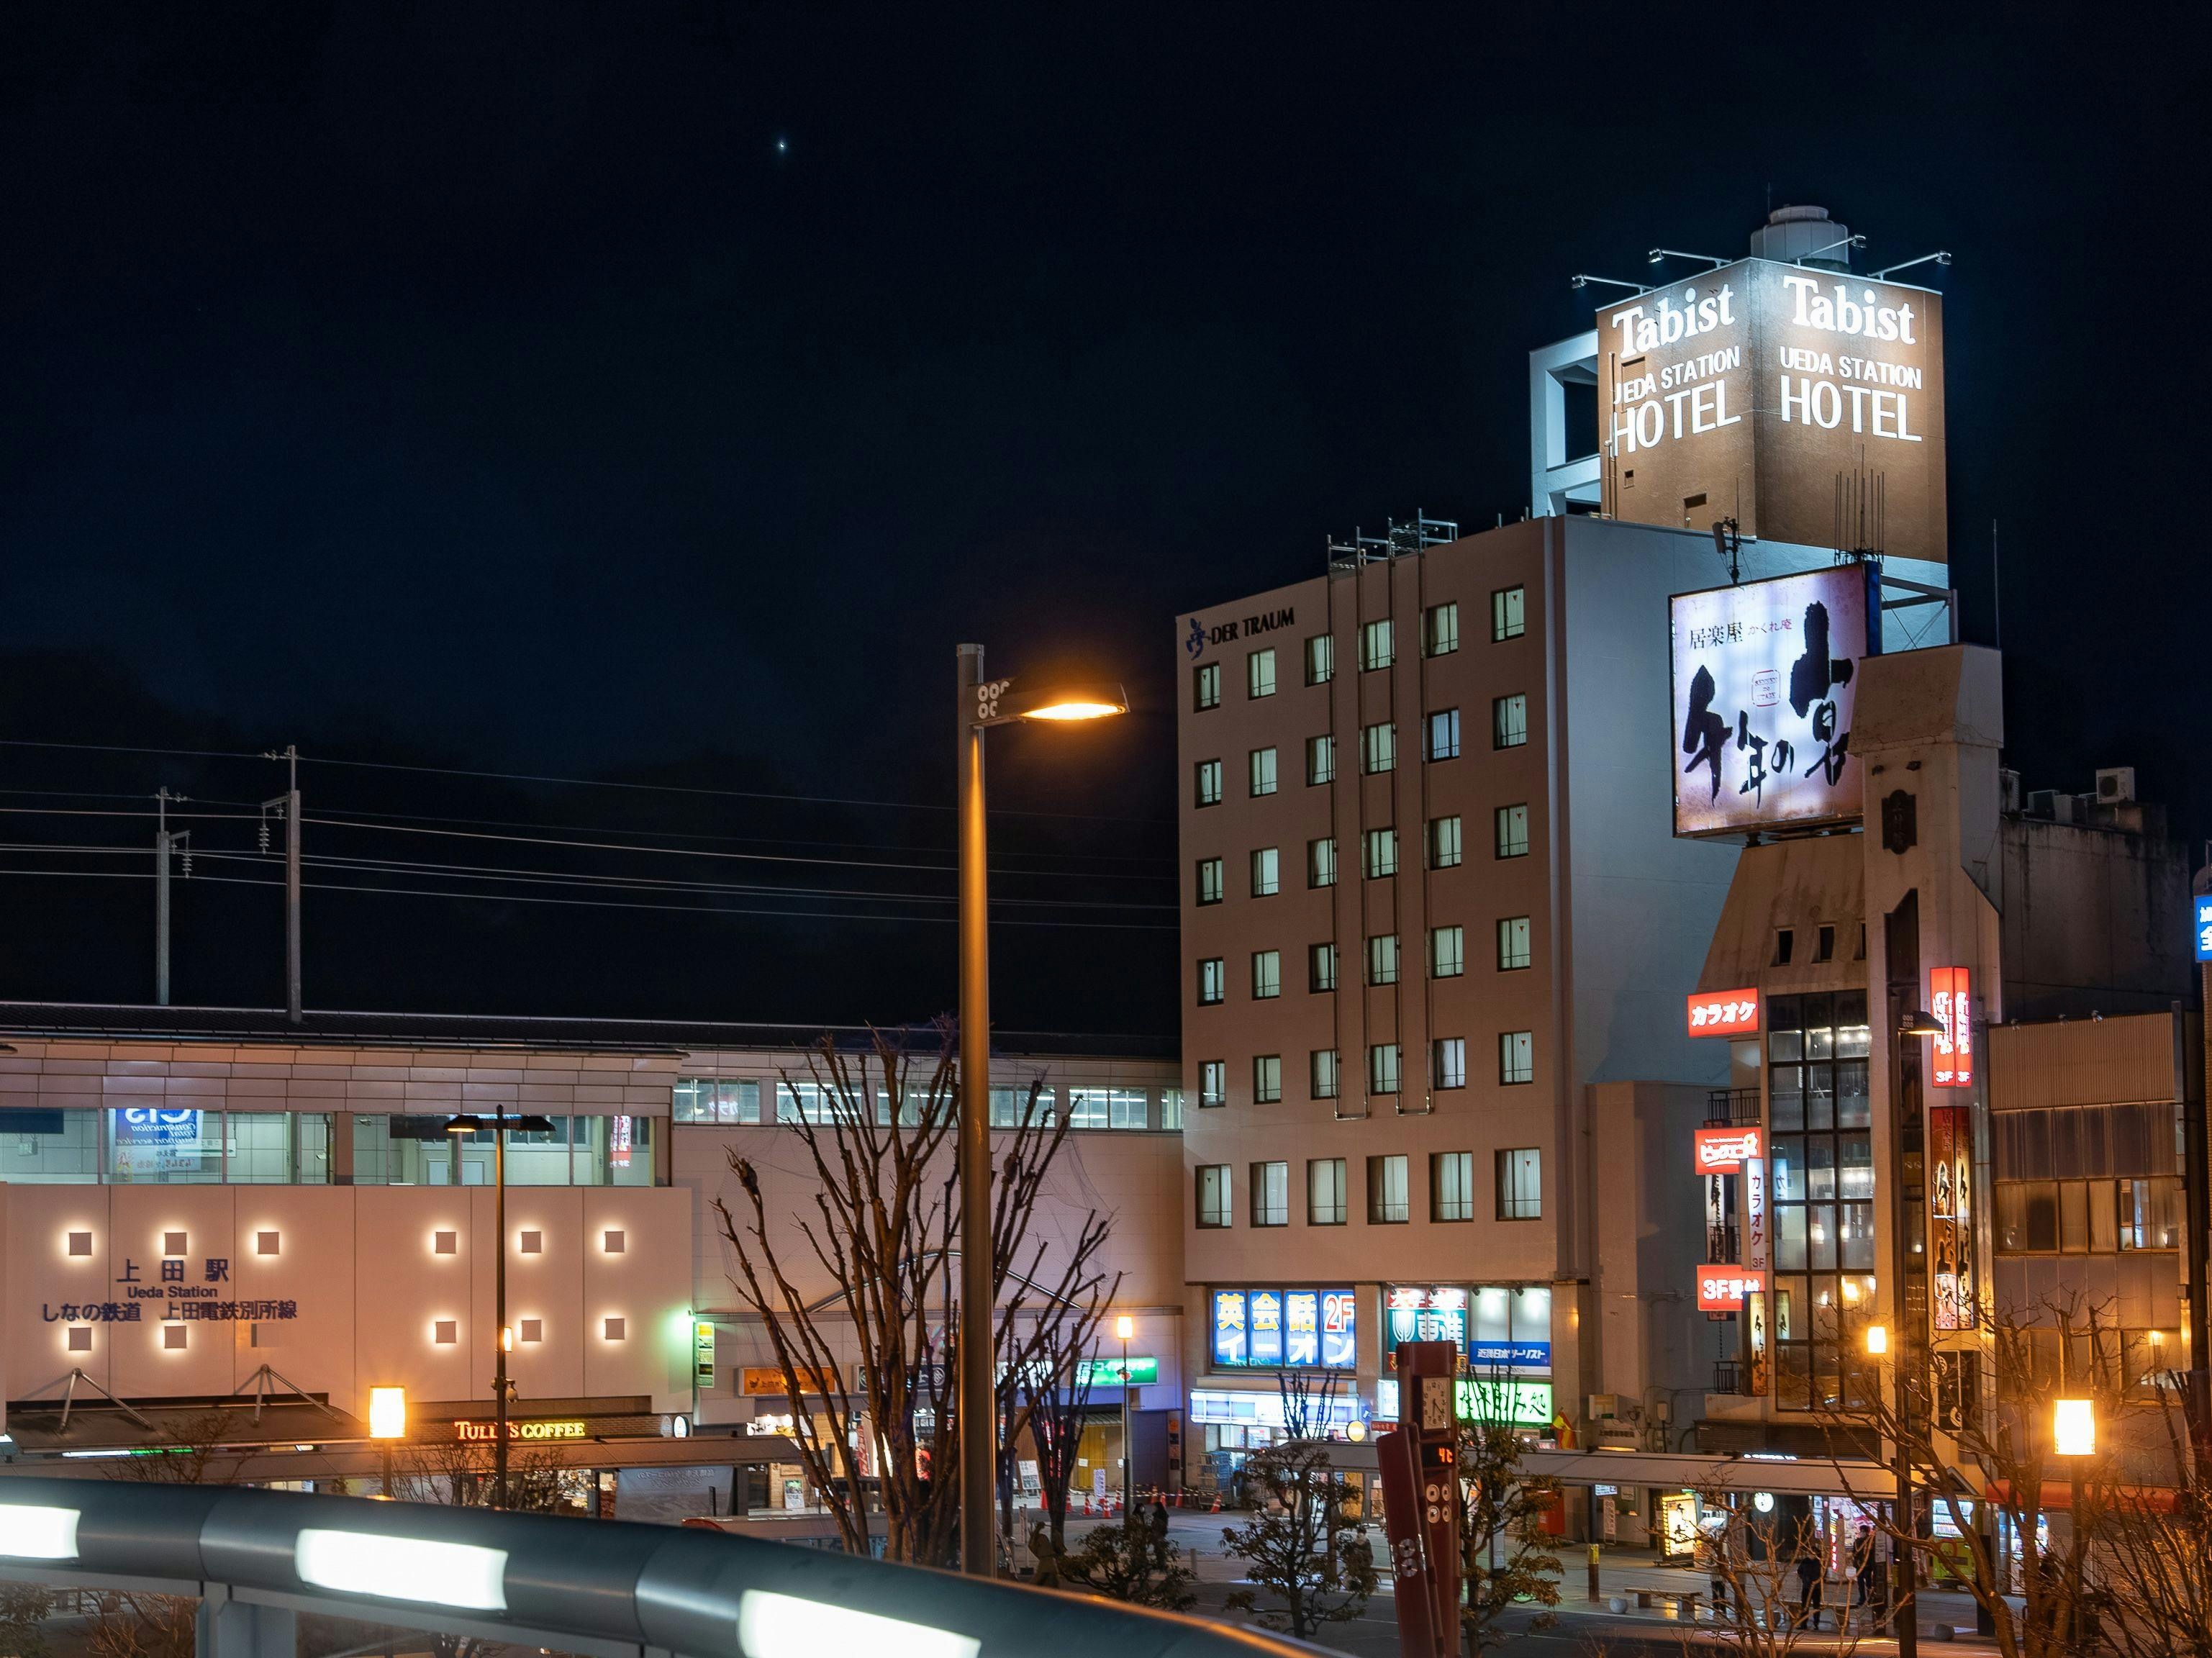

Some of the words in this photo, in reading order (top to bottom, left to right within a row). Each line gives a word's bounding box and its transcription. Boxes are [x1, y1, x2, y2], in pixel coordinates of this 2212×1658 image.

[1612, 284, 1735, 358] Tabist
[1783, 276, 1916, 345] Tabist
[1661, 346, 1740, 389] STATION
[1780, 346, 1833, 374] UEDA
[1839, 355, 1922, 389] STATION
[1610, 379, 1741, 457] HOTEL
[1781, 375, 1922, 442] HOTEL
[1211, 622, 1239, 645] DER
[1243, 607, 1295, 636] TRAUM
[1692, 1000, 1757, 1027] カラオケ
[1936, 1071, 1954, 1082] 3F
[1957, 1071, 1970, 1082] 3F
[1751, 1174, 1763, 1246] カラオケ
[117, 1259, 229, 1282] 上田駅
[1752, 1258, 1764, 1268] 3F
[127, 1286, 164, 1298] Ueda
[168, 1285, 218, 1298] Station
[43, 1303, 142, 1322] しなの鉄道
[160, 1300, 297, 1321] 上田電鉄別所線
[1217, 1292, 1316, 1332] 英会話
[1323, 1294, 1355, 1333] 2F
[1218, 1332, 1355, 1364] イーオン
[454, 1421, 520, 1439] TULL'S
[520, 1422, 586, 1438] COFFEE
